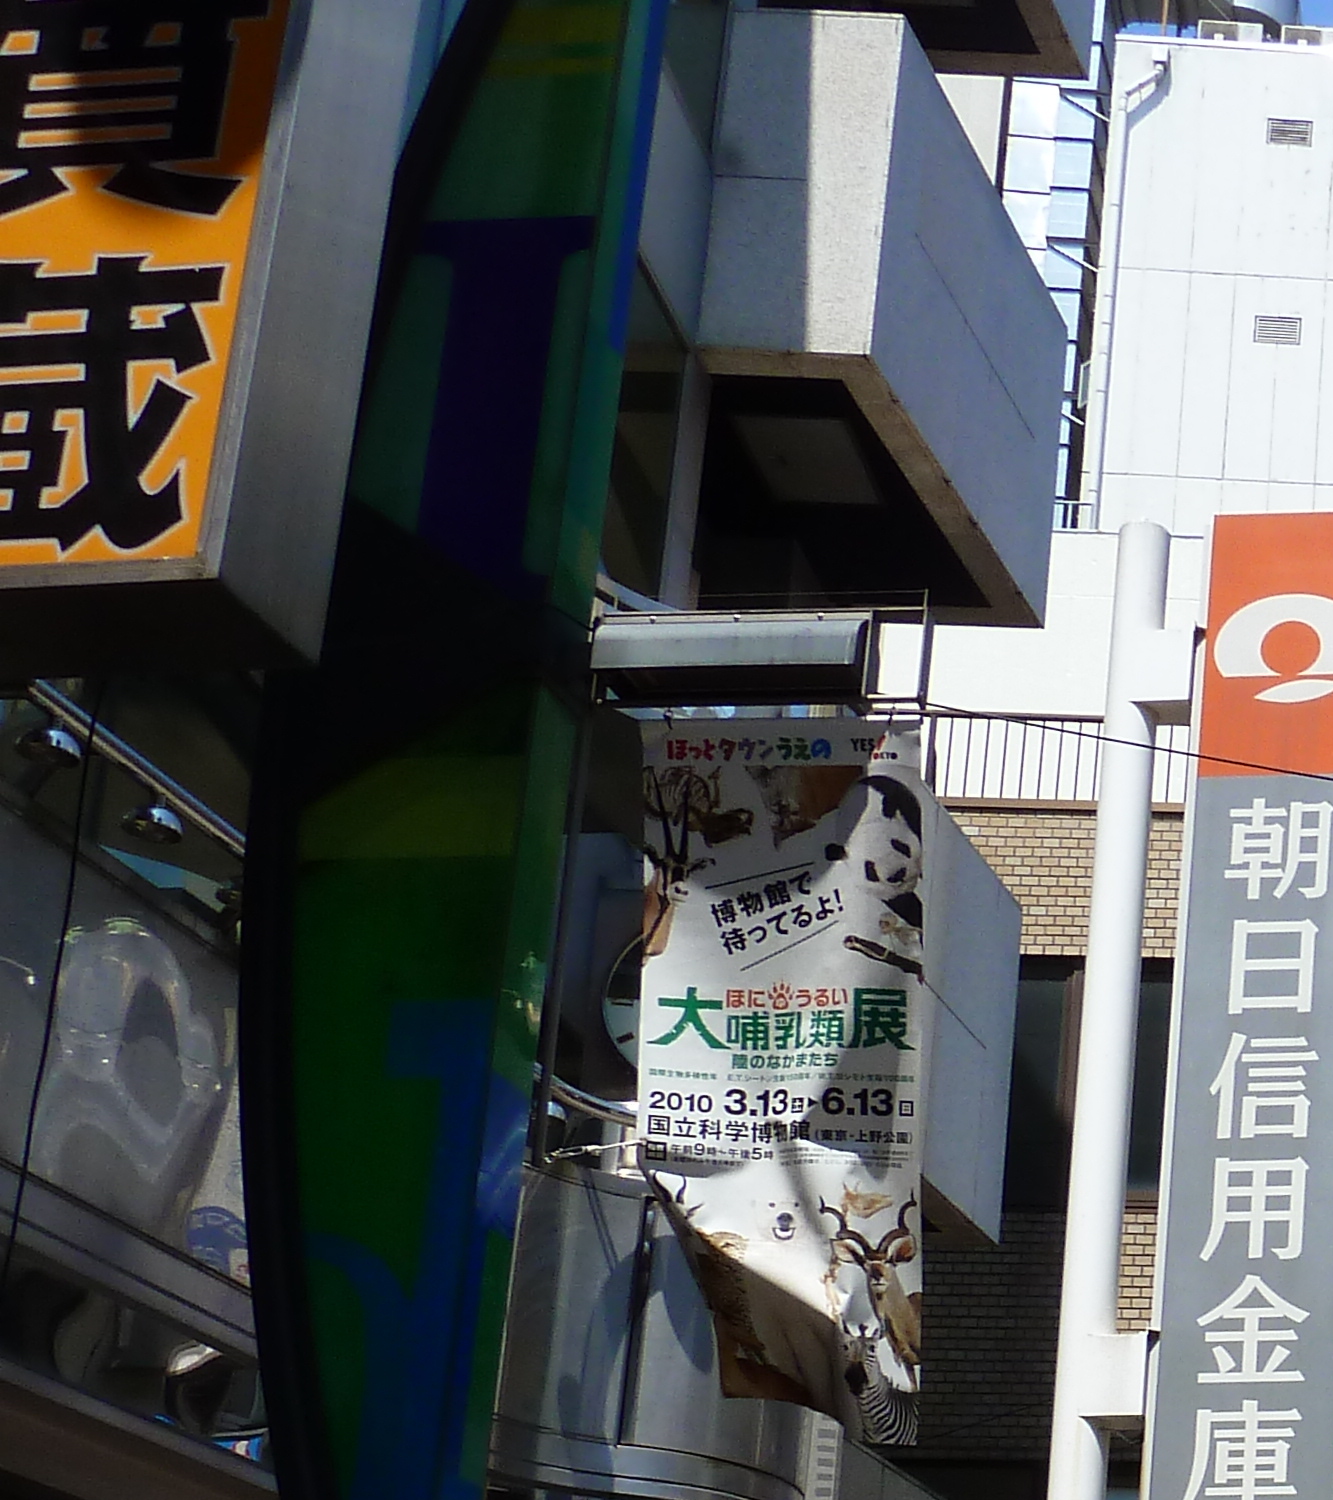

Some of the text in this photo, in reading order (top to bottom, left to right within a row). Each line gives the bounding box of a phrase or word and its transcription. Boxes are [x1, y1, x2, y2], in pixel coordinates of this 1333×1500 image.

[667, 737, 832, 761] ほっとタウンうえの
[711, 871, 812, 928] 博物館で
[720, 888, 845, 954] 待ってるよ!
[646, 987, 916, 1050] 大哺乳類展
[649, 1091, 712, 1113] 2010
[724, 1087, 788, 1117] 3.13
[821, 1087, 894, 1117] 6.13
[648, 1115, 811, 1143] 国立科学博物館
